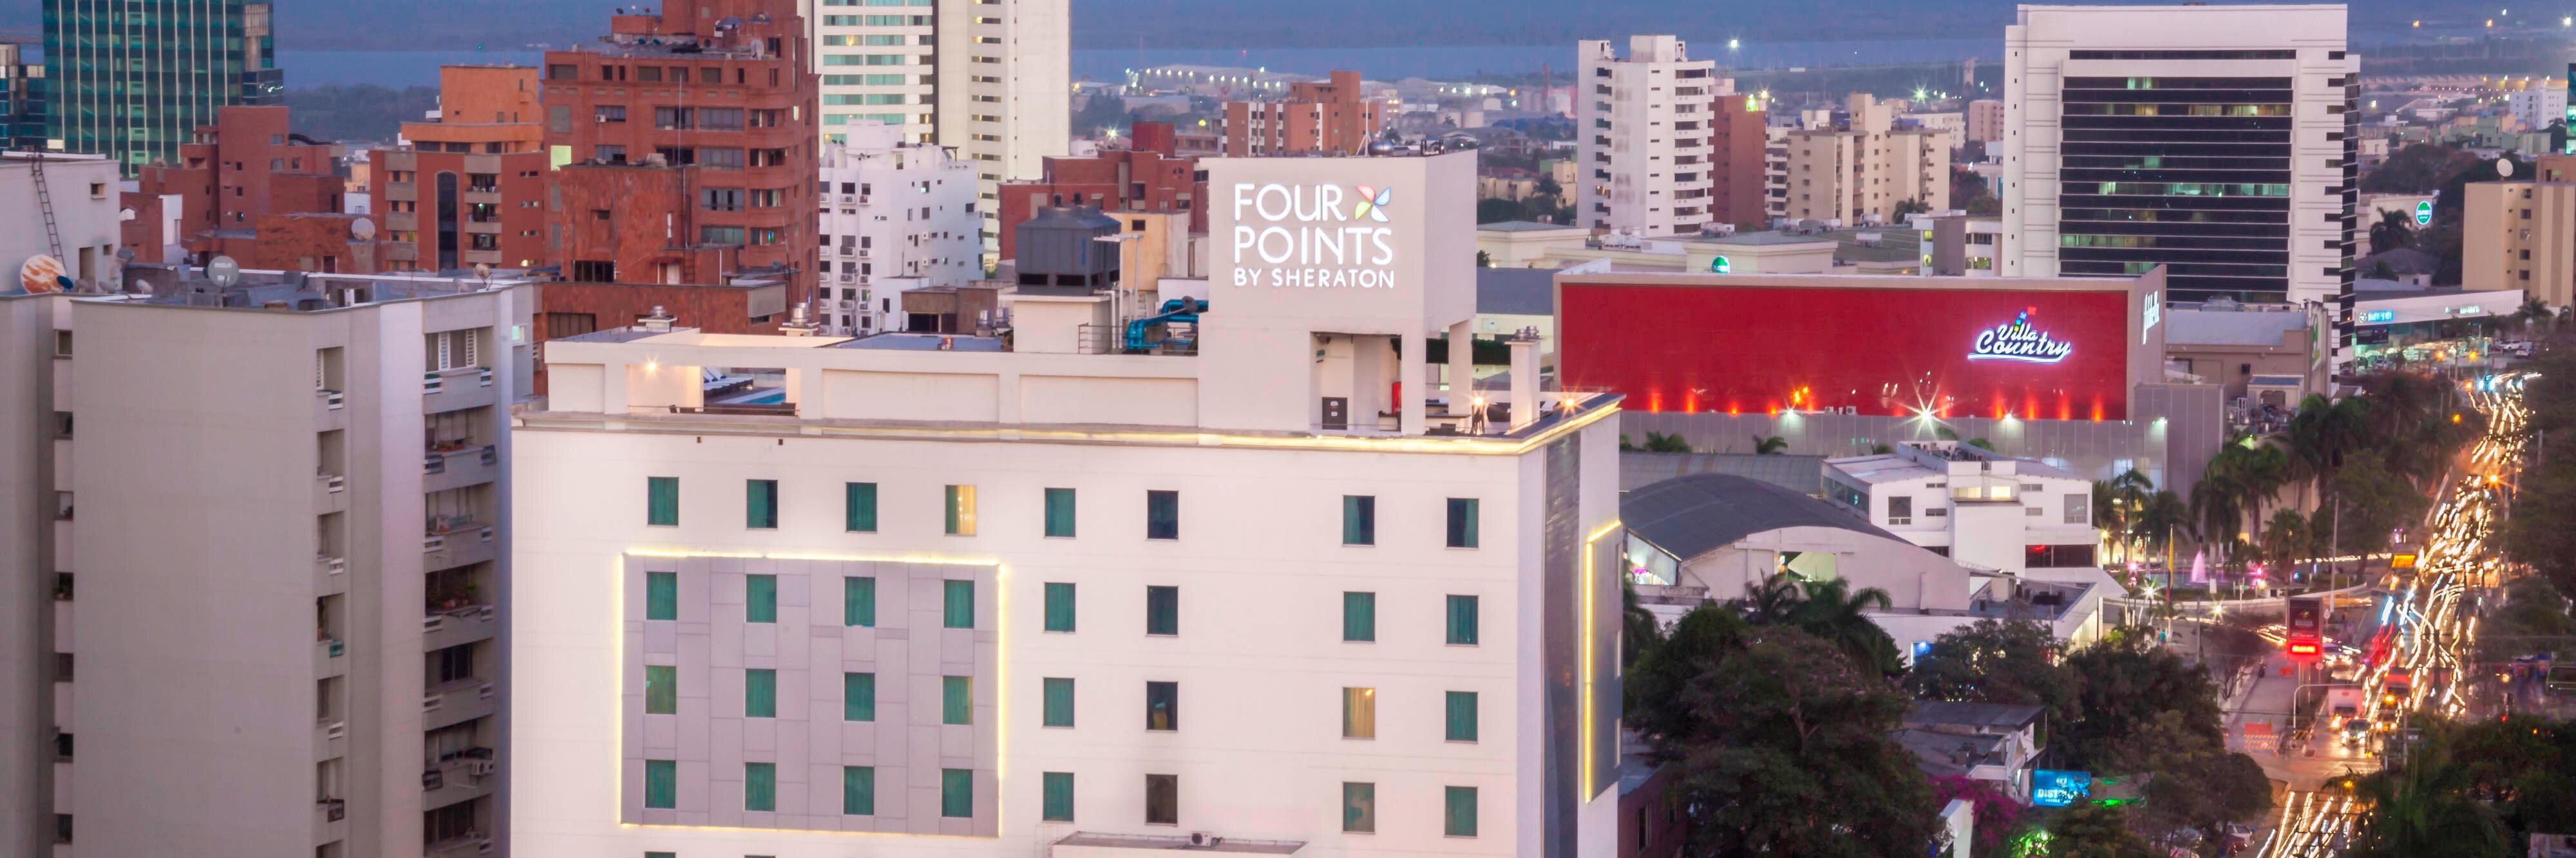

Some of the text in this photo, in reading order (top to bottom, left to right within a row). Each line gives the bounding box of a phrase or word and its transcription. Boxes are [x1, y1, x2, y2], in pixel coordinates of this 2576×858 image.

[1234, 183, 1347, 221] FOUR
[1234, 226, 1393, 265] POINTS
[1234, 267, 1394, 288] BY SHERATON
[1975, 329, 2071, 357] Country
[1997, 322, 2038, 341] Villa
